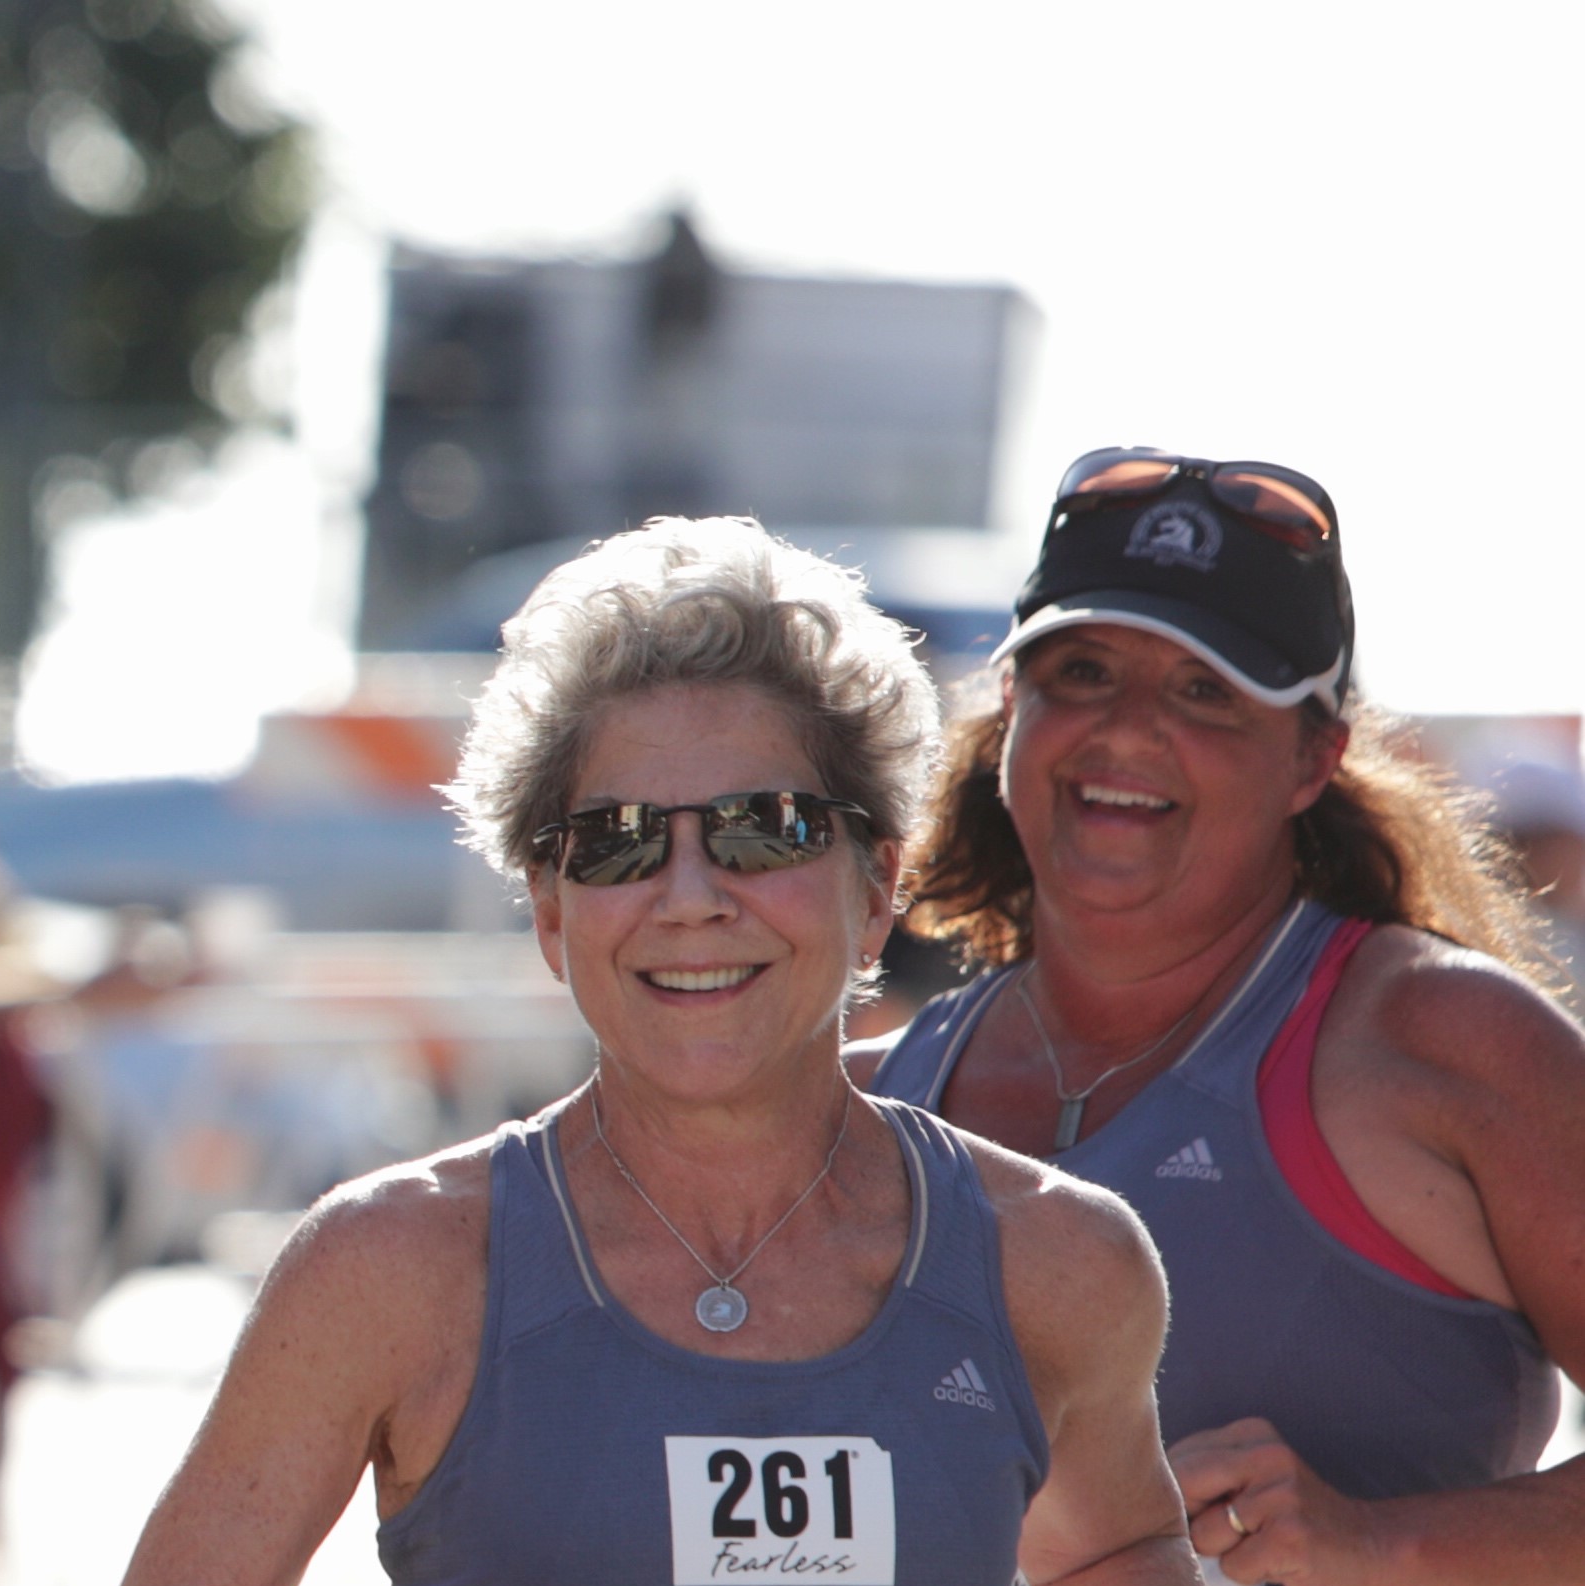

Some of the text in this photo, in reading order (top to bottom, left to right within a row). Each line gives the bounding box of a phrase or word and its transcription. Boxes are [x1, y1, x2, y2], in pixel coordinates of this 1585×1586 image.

[1155, 1164, 1223, 1183] adidas
[934, 1385, 996, 1411] adidas
[705, 1449, 854, 1540] 261
[711, 1541, 857, 1578] Fearless
